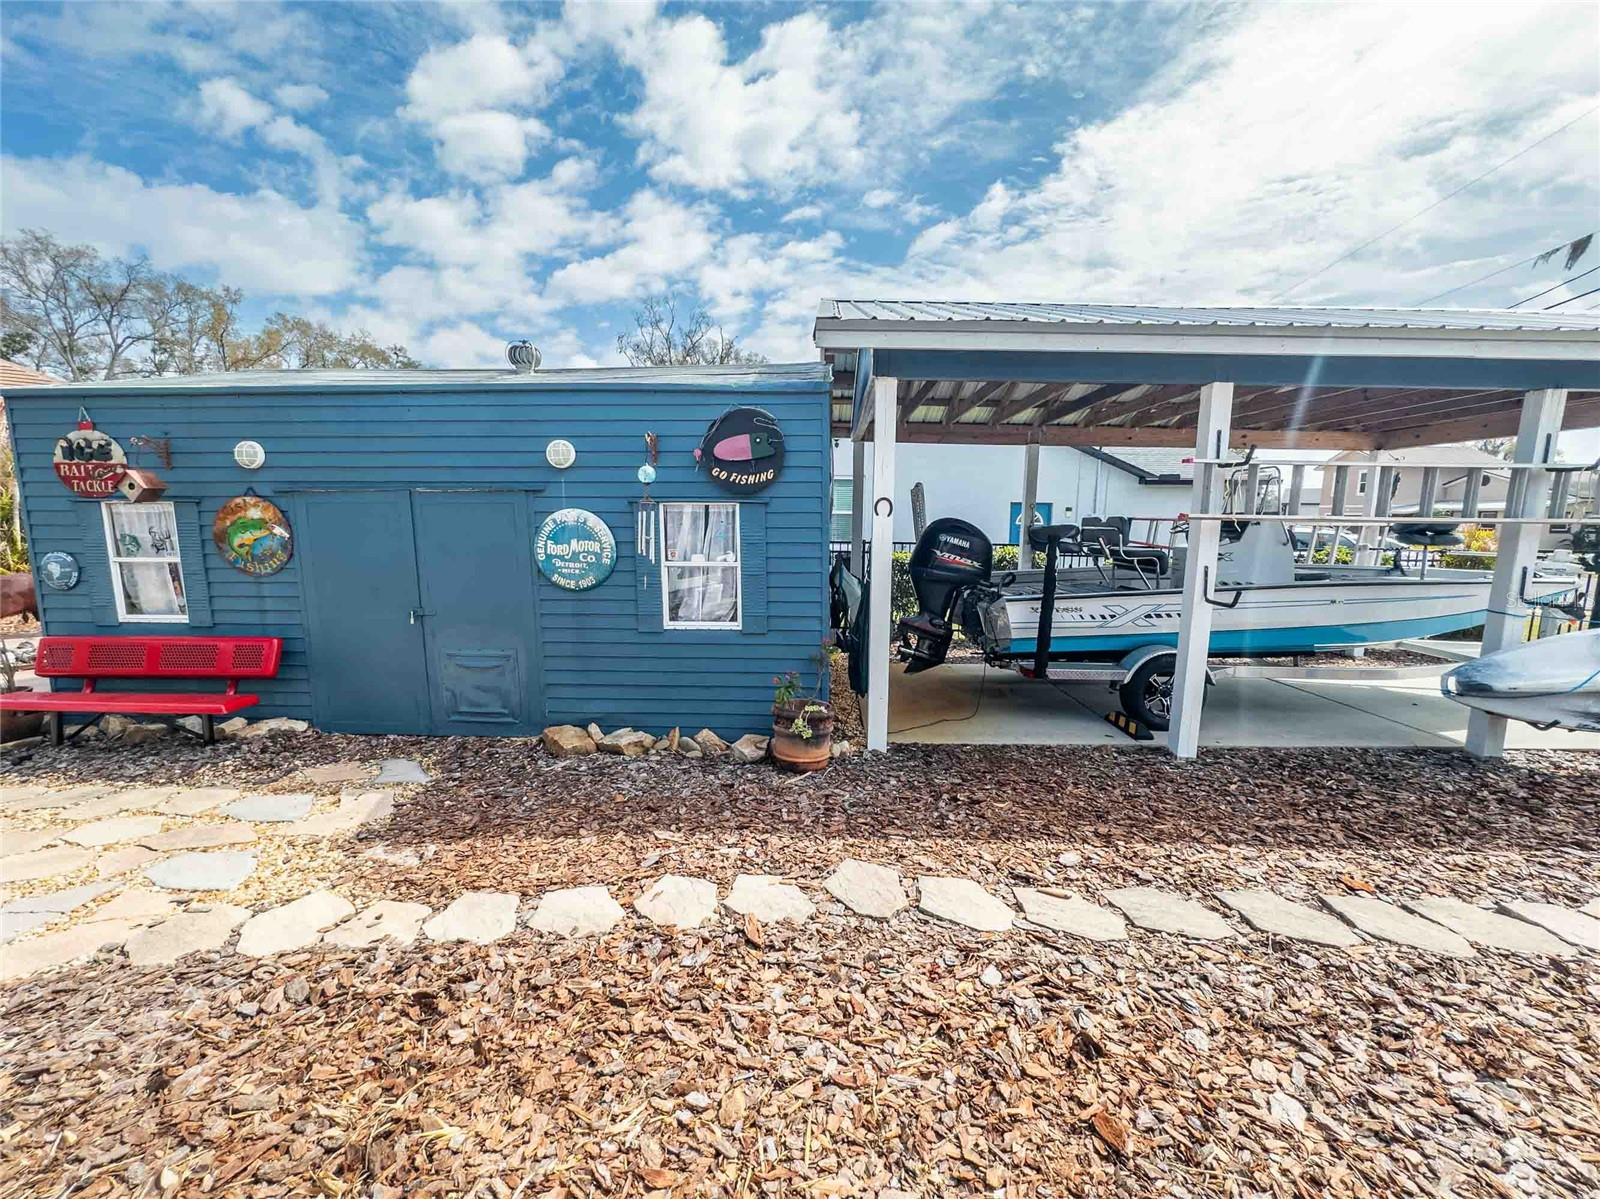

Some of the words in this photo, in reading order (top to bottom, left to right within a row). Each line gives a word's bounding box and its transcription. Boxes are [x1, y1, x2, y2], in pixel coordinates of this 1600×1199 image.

[60, 464, 95, 477] BAIT
[711, 467, 728, 480] GO
[729, 469, 774, 485] FISHING
[71, 479, 114, 492] TACKLE
[537, 520, 557, 560] GENUINE
[946, 536, 971, 549] YAMAHA
[546, 539, 570, 556] FORD
[565, 538, 601, 559] MOTOR
[552, 574, 577, 589] SINCE
[578, 575, 596, 589] 1903
